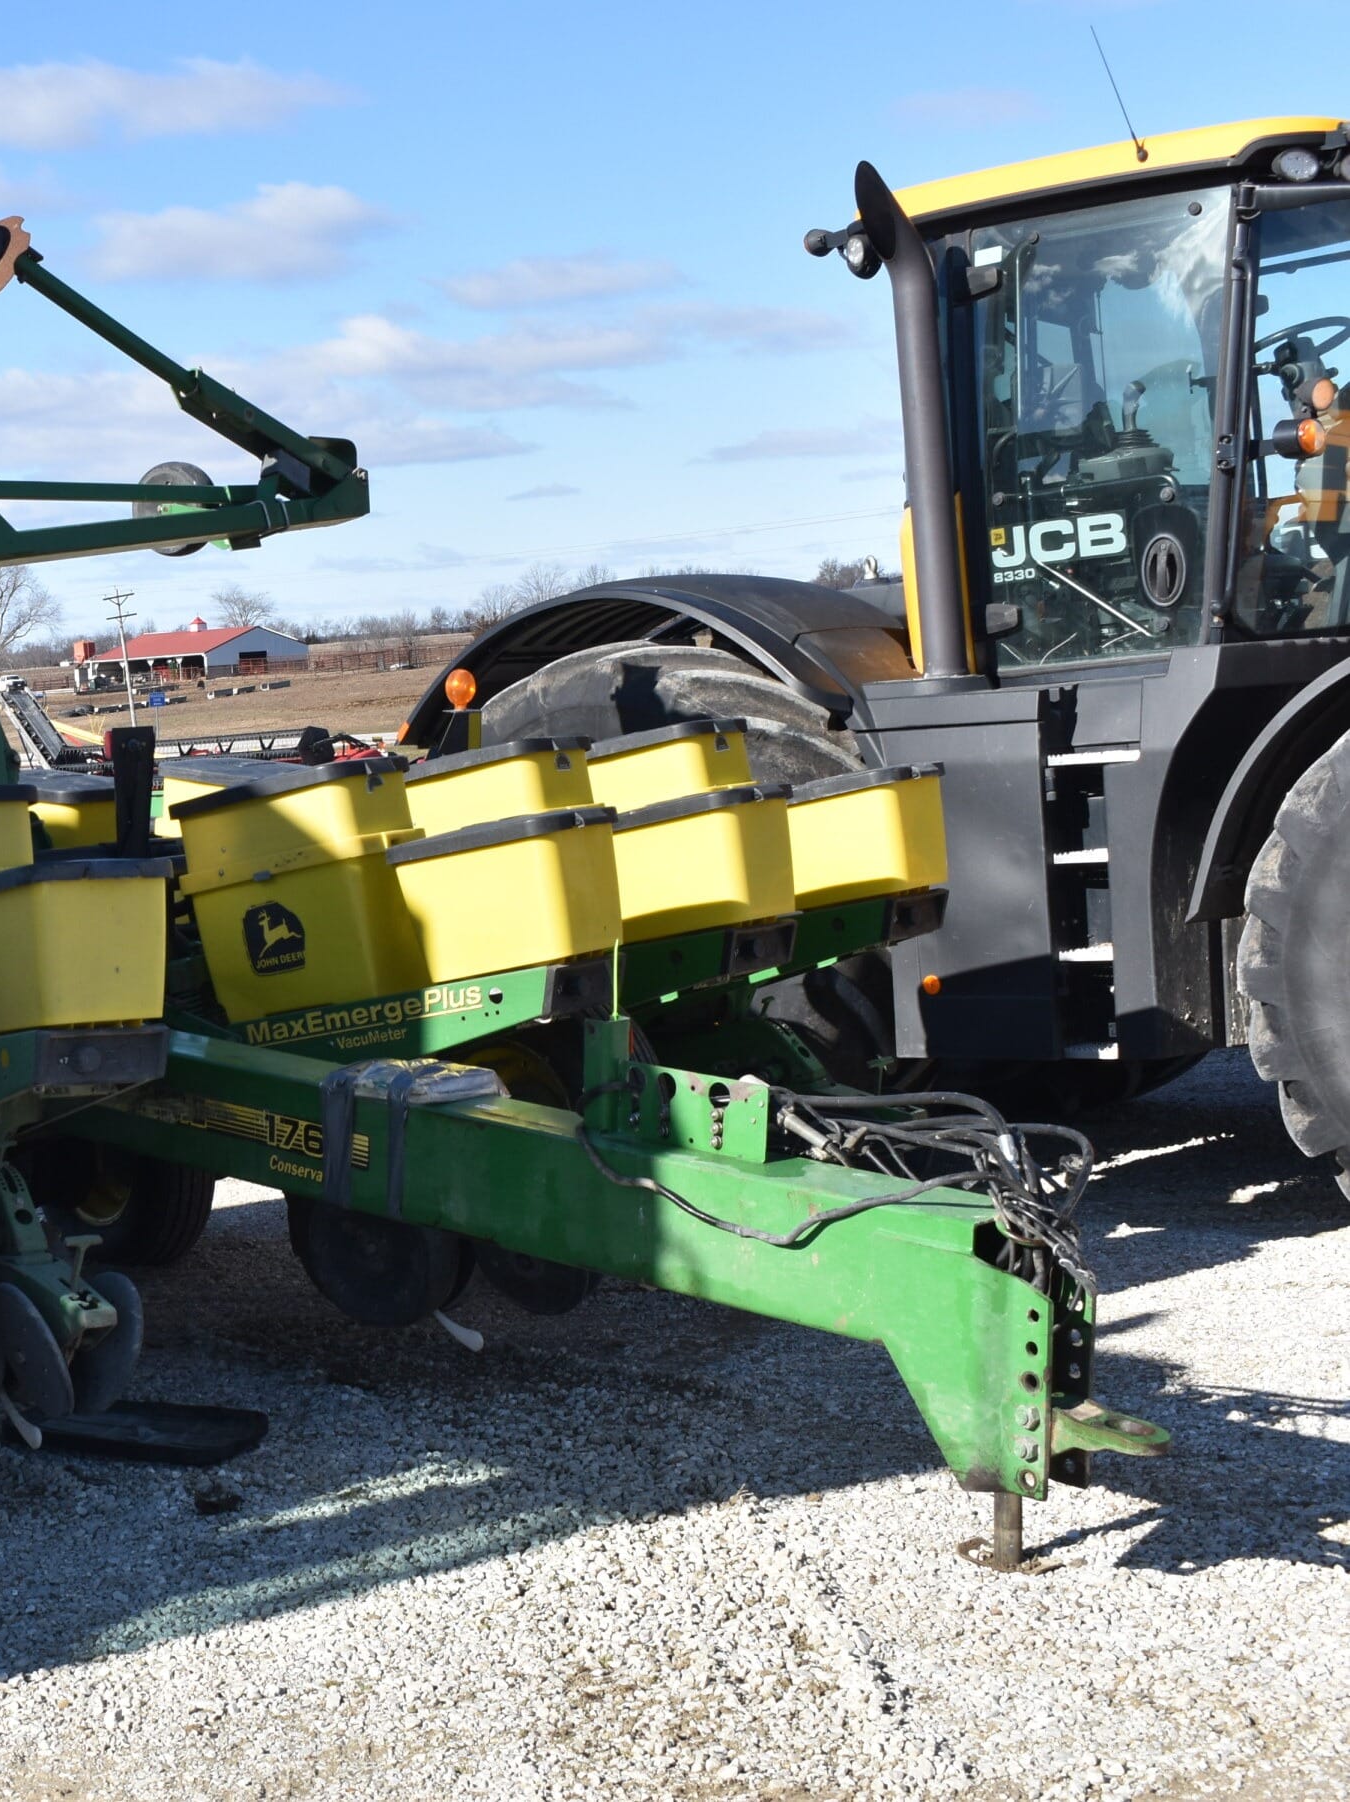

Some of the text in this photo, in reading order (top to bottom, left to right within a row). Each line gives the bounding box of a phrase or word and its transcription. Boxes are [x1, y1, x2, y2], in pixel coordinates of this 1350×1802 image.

[992, 513, 1127, 568] JCB
[994, 568, 1036, 583] 8330
[256, 957, 278, 968] JOHN
[336, 1027, 407, 1050] VacuMeter
[264, 1109, 325, 1158] 176
[269, 1154, 324, 1183] Conserva
